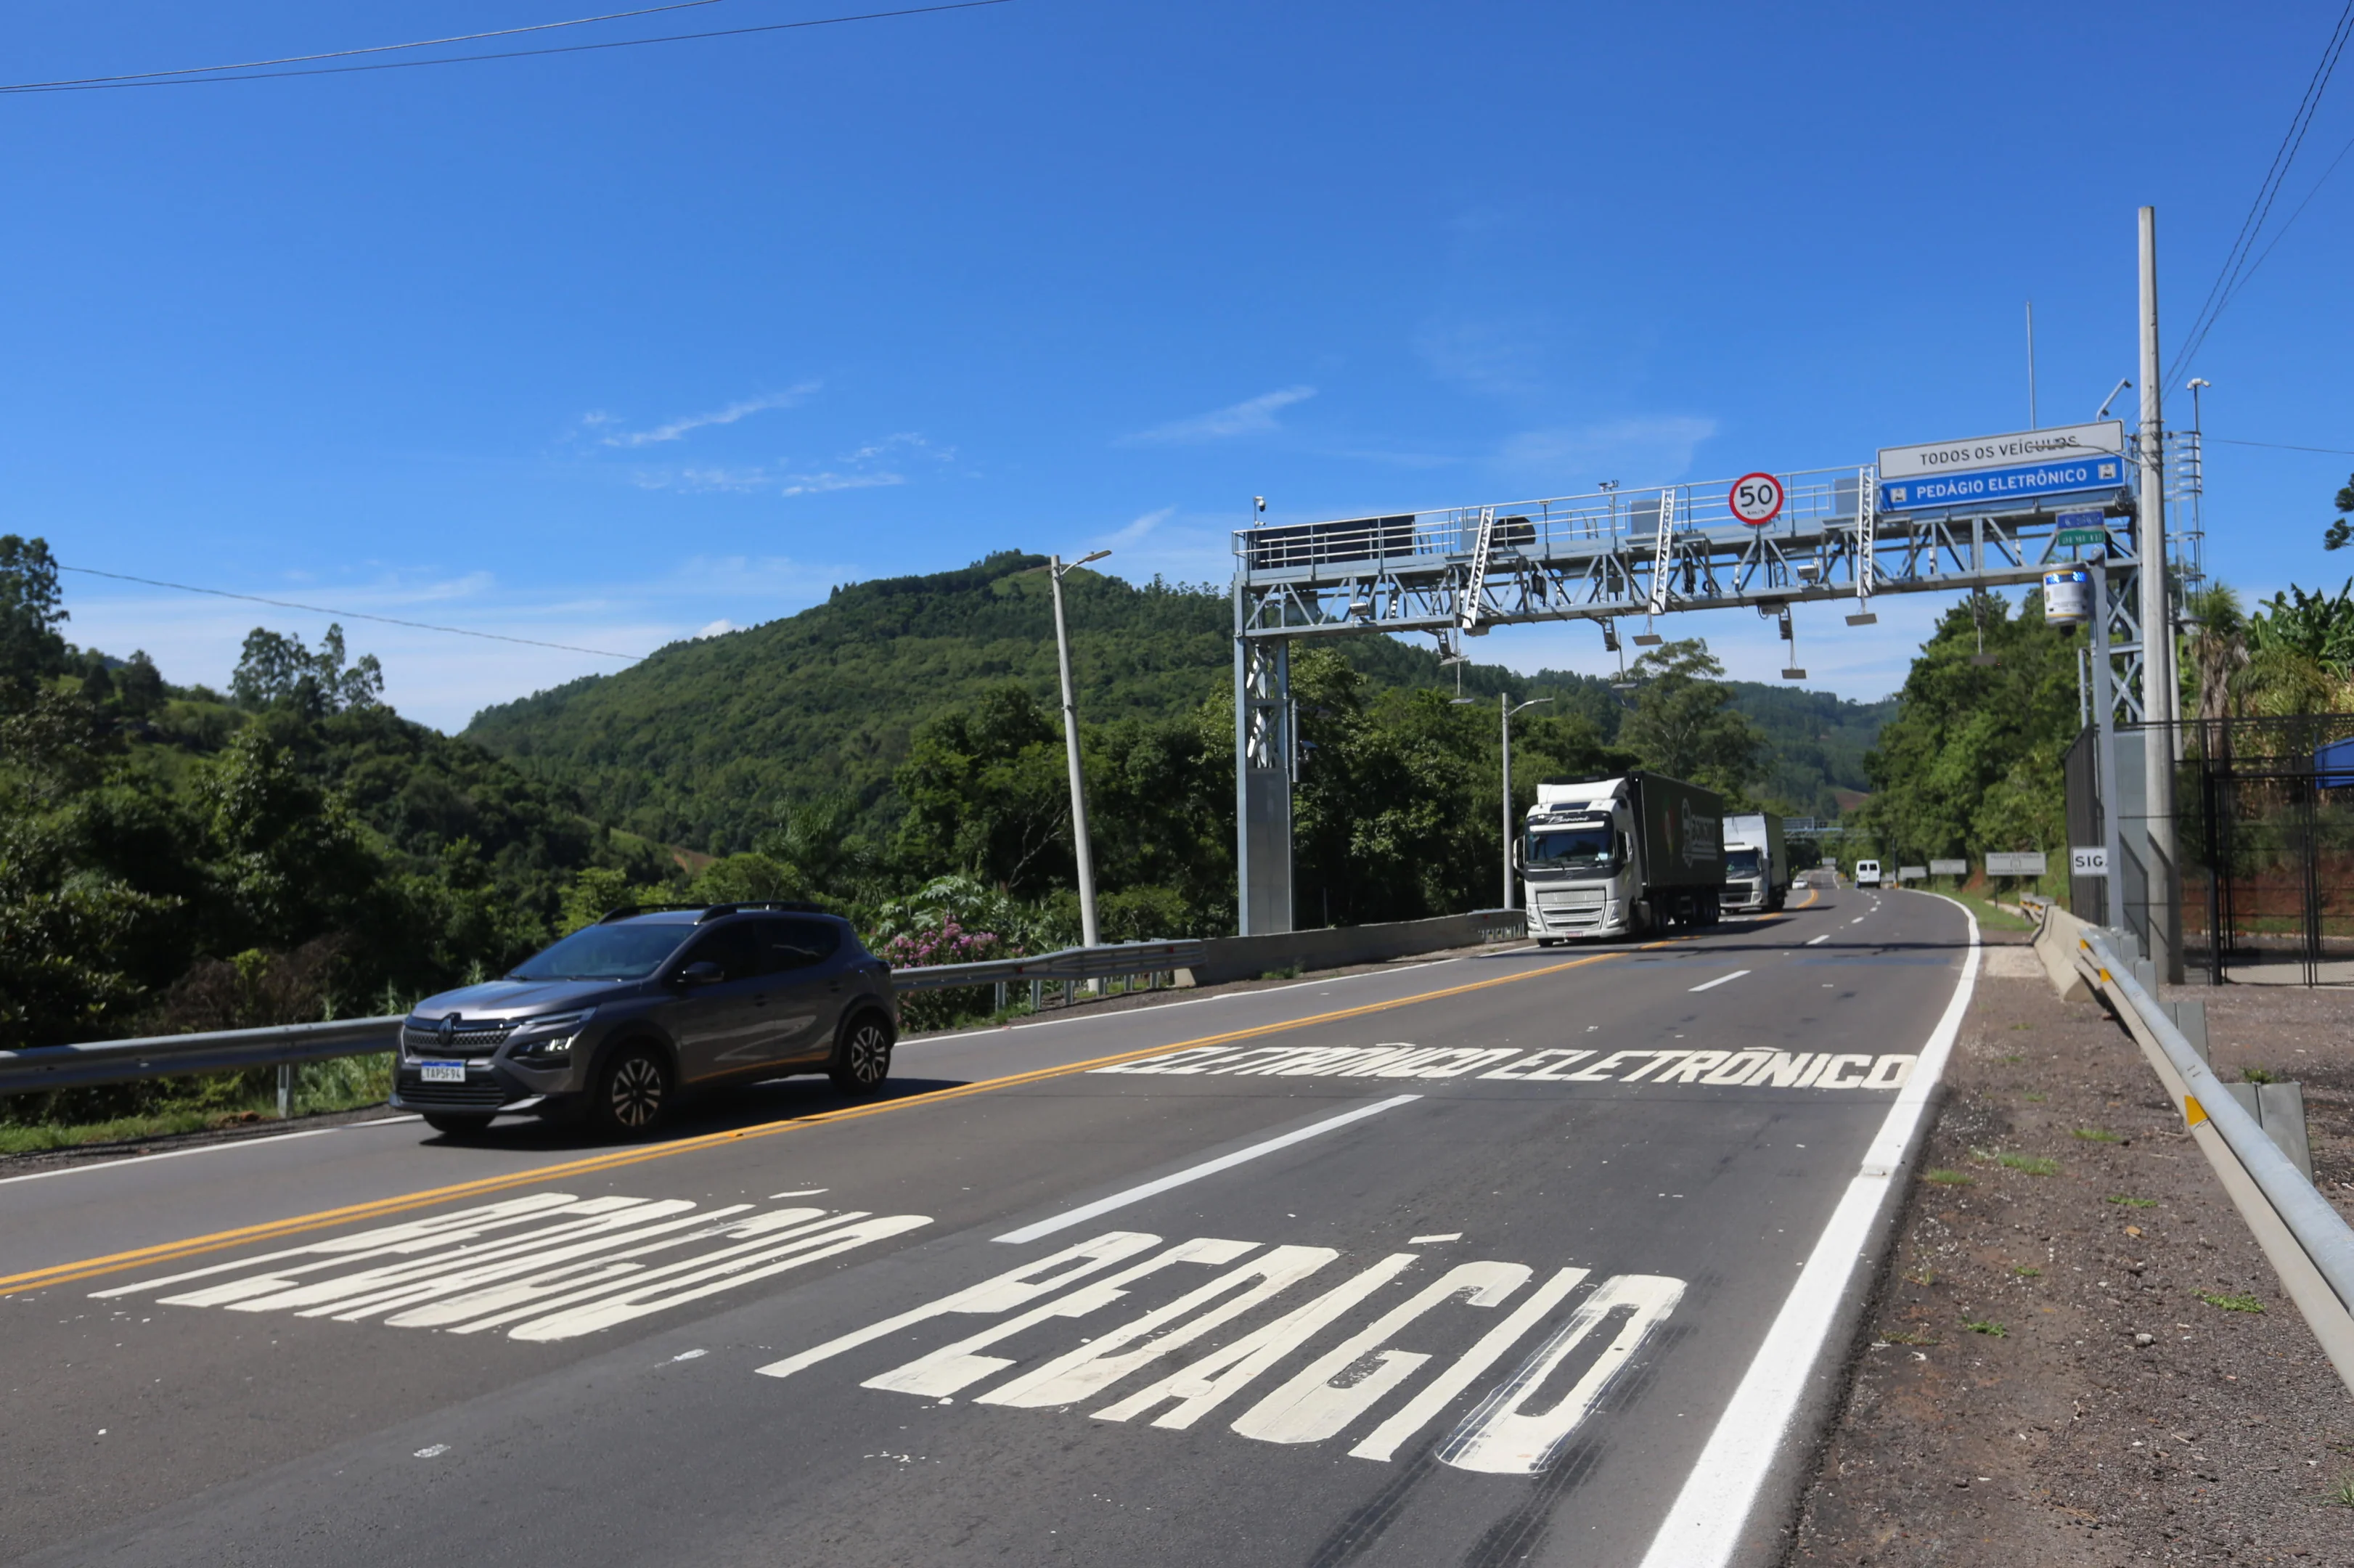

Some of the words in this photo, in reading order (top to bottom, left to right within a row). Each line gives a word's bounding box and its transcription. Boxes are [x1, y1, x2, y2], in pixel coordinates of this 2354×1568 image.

[1920, 449, 1970, 465] TODOS
[1974, 446, 1995, 460] OS
[1999, 436, 2080, 456] VEÍCULOS
[1740, 484, 1773, 507] 50
[1916, 479, 1984, 499] PEDÁGIO
[1988, 468, 2087, 491] ELETRÔNICO
[2075, 855, 2108, 867] SIG
[1084, 1042, 1523, 1078] ELETRÔNICO
[1476, 1047, 1918, 1088] ELETRÔNICO
[87, 1188, 934, 1341] PEDÁGIO
[754, 1231, 1688, 1474] PEDÁGIO
